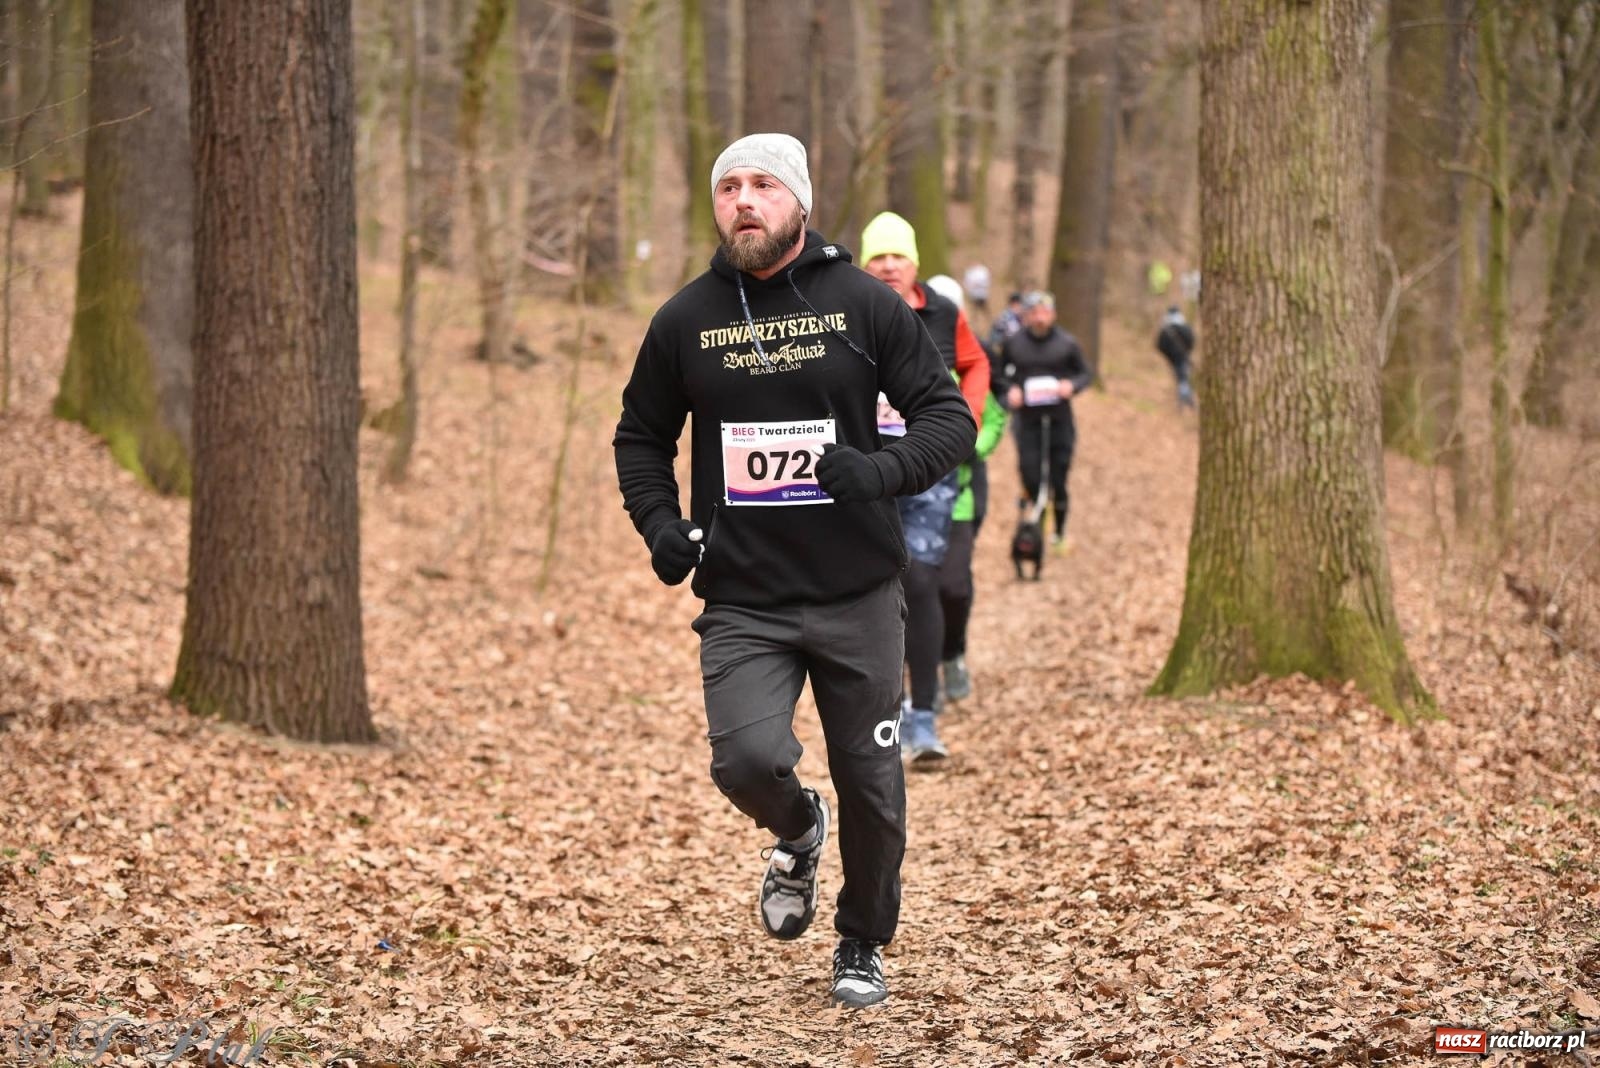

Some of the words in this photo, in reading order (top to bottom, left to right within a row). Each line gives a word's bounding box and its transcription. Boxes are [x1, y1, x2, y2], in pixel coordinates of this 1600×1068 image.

[700, 312, 847, 349] STOWARZYSZENIE
[750, 366, 777, 376] BEARD
[778, 362, 802, 372] CLAN
[732, 427, 756, 436] BIEG
[758, 425, 825, 436] Twardziela
[747, 450, 813, 481] 072
